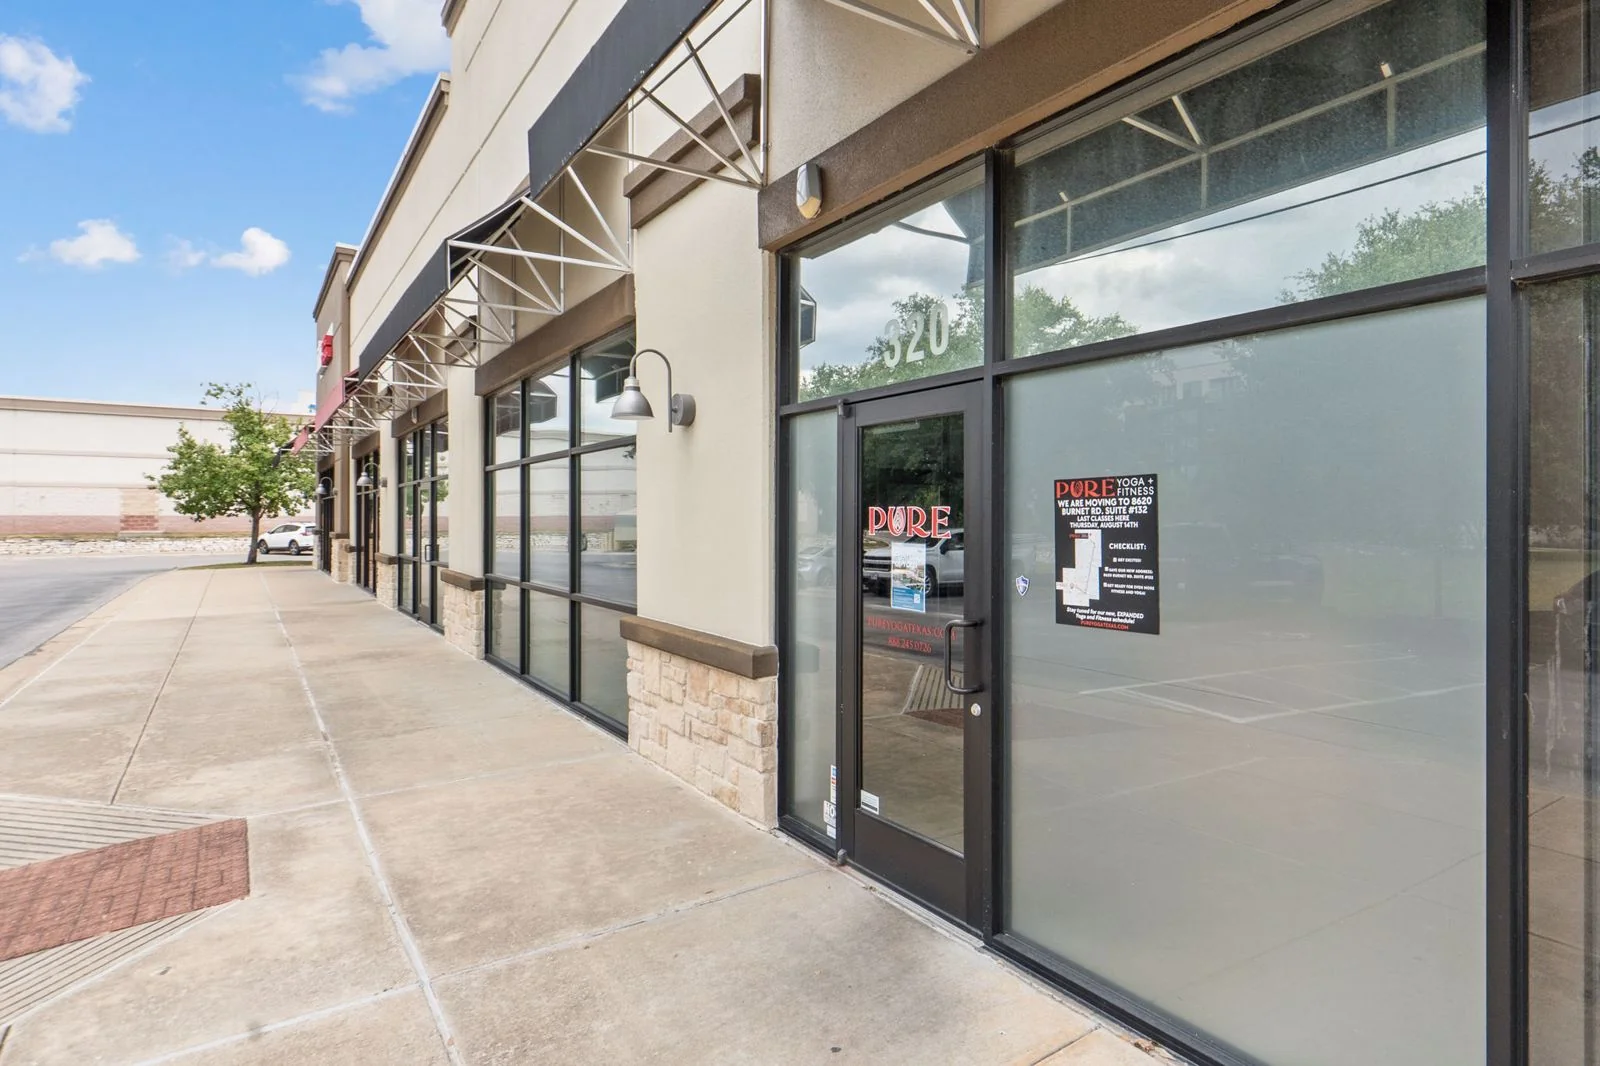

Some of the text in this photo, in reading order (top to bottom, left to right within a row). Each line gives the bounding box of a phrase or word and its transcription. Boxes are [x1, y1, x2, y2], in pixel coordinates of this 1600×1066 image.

[884, 302, 949, 368] 320
[1116, 477, 1145, 487] YOGA
[1055, 478, 1116, 499] PURE
[1116, 486, 1155, 497] FITNESS
[1058, 497, 1153, 508] WE ARE MOVING TO 8620
[1061, 505, 1148, 516] BURNET RD. SUITE #132
[868, 506, 952, 539] PURE
[1100, 521, 1123, 529] AUGUST
[1108, 542, 1147, 550] CHECKLIST:
[1116, 610, 1144, 619] EXPANDED
